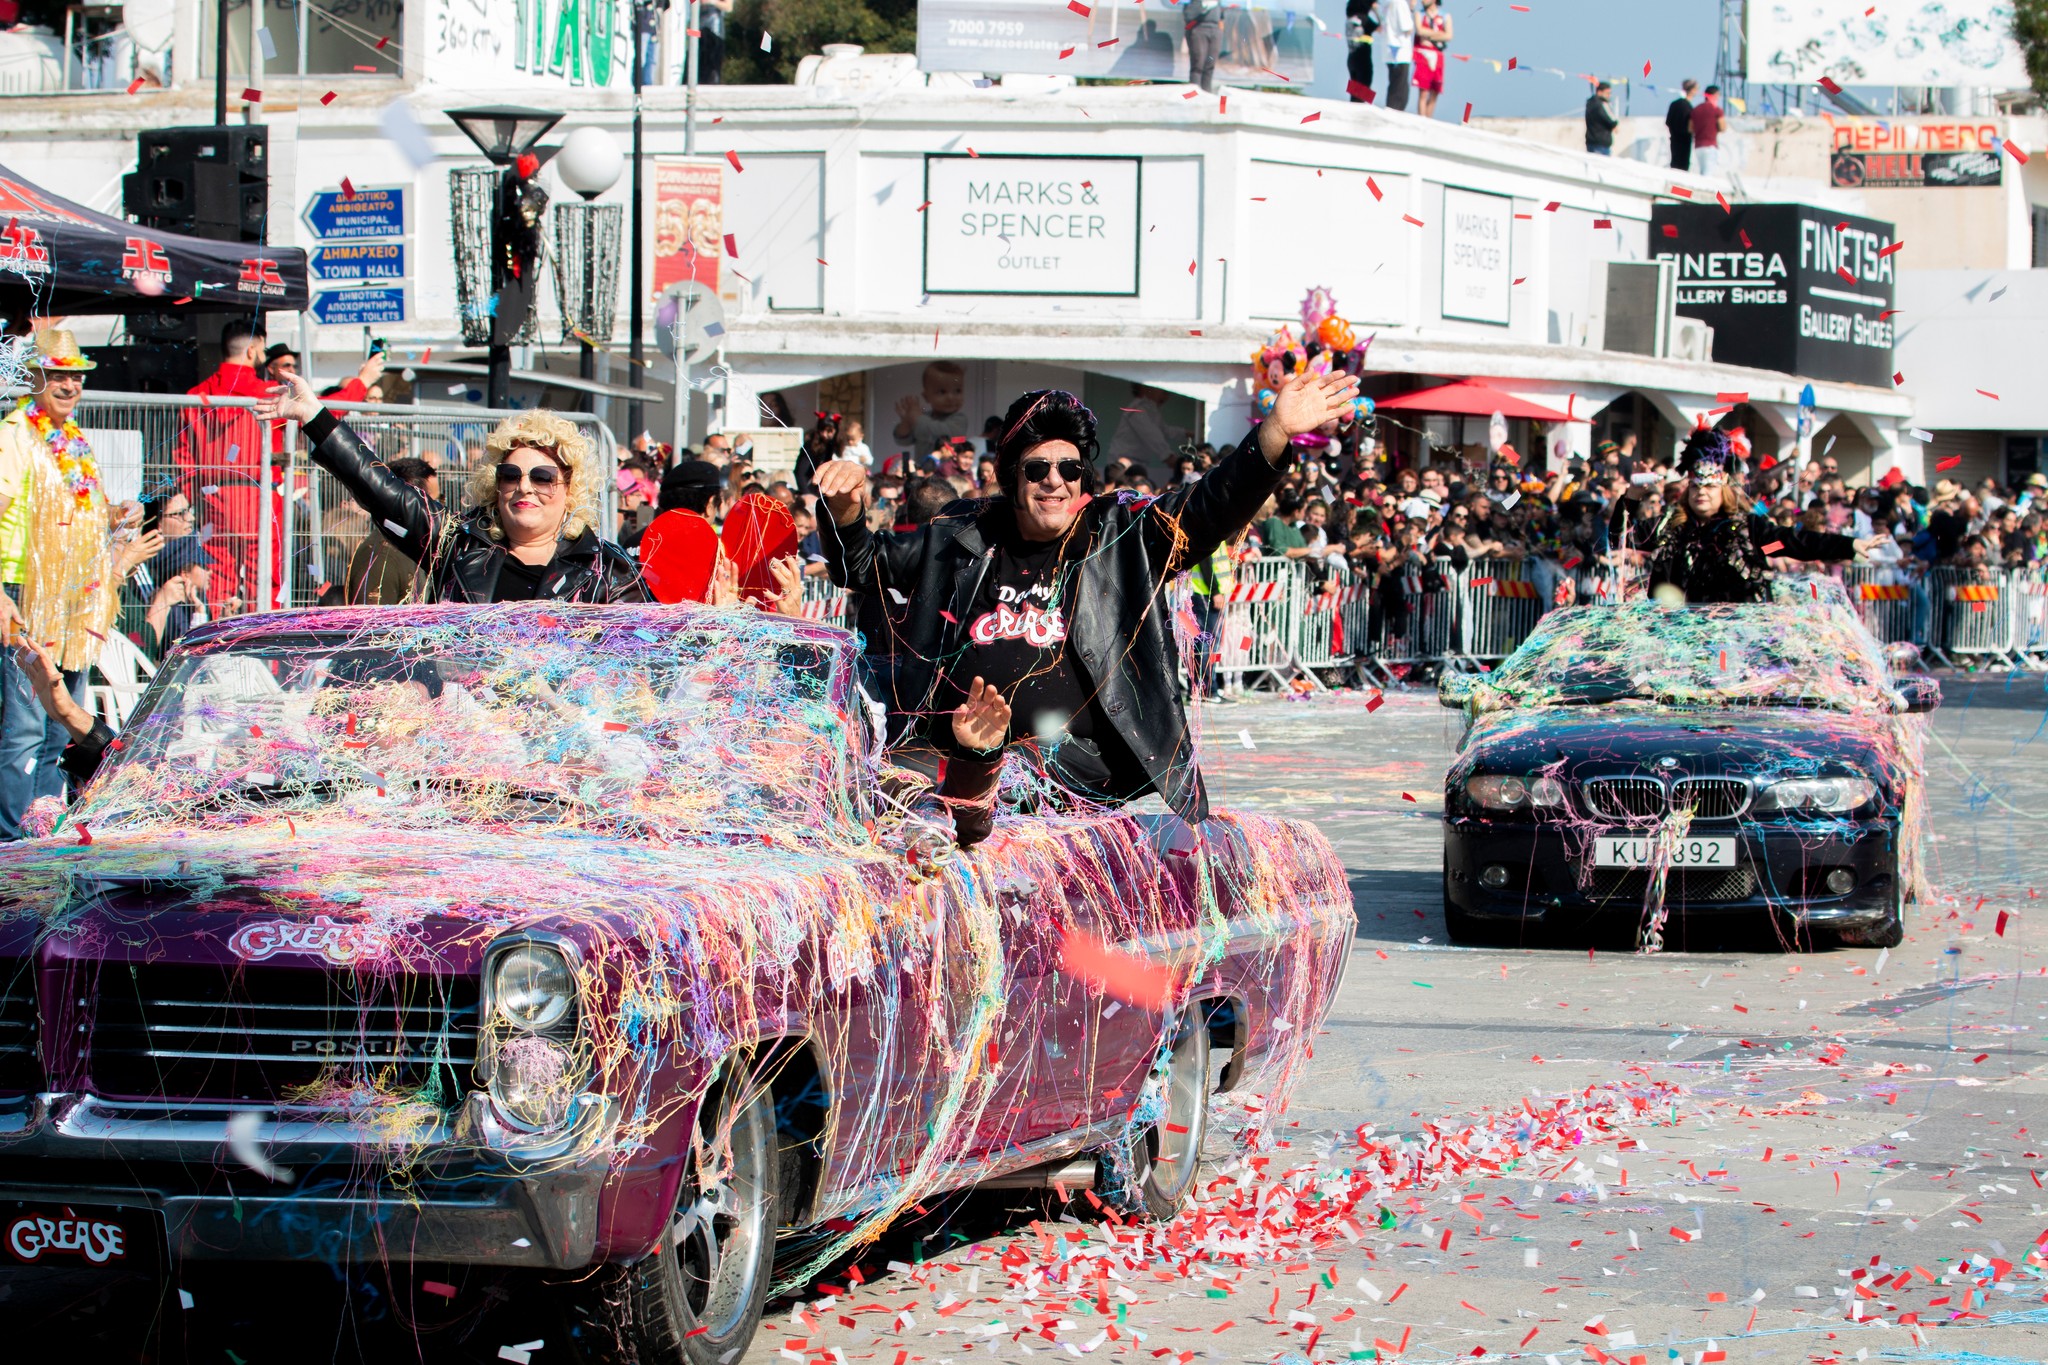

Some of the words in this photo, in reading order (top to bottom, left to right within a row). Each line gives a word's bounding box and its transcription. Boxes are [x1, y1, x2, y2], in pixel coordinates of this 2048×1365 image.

[947, 19, 985, 35] 7000
[987, 20, 1025, 37] 7959
[1865, 153, 1924, 180] HELL
[968, 181, 1073, 206] MARKS
[1080, 181, 1100, 206] &
[335, 215, 389, 227] MUNICIPAL
[960, 213, 1105, 239] SPENCER
[324, 224, 402, 237] AMPHITHEATRE
[322, 245, 399, 261] ΔΗΜΑΡΧΕΙΟ
[1800, 218, 1894, 286] FINETSA
[997, 255, 1062, 270] OUTLET
[122, 269, 173, 284] RACING
[322, 265, 361, 279] TOWN
[366, 264, 401, 277] HALL
[237, 280, 261, 294] DRIVE
[261, 283, 286, 297] CHAIN
[338, 290, 386, 301] ΔΗΜΟΤΙΚΑ
[325, 312, 359, 324] PUBLIC
[362, 310, 401, 322] TOILETS
[975, 608, 1066, 645] GREASE
[10, 1217, 124, 1263] GREASE
